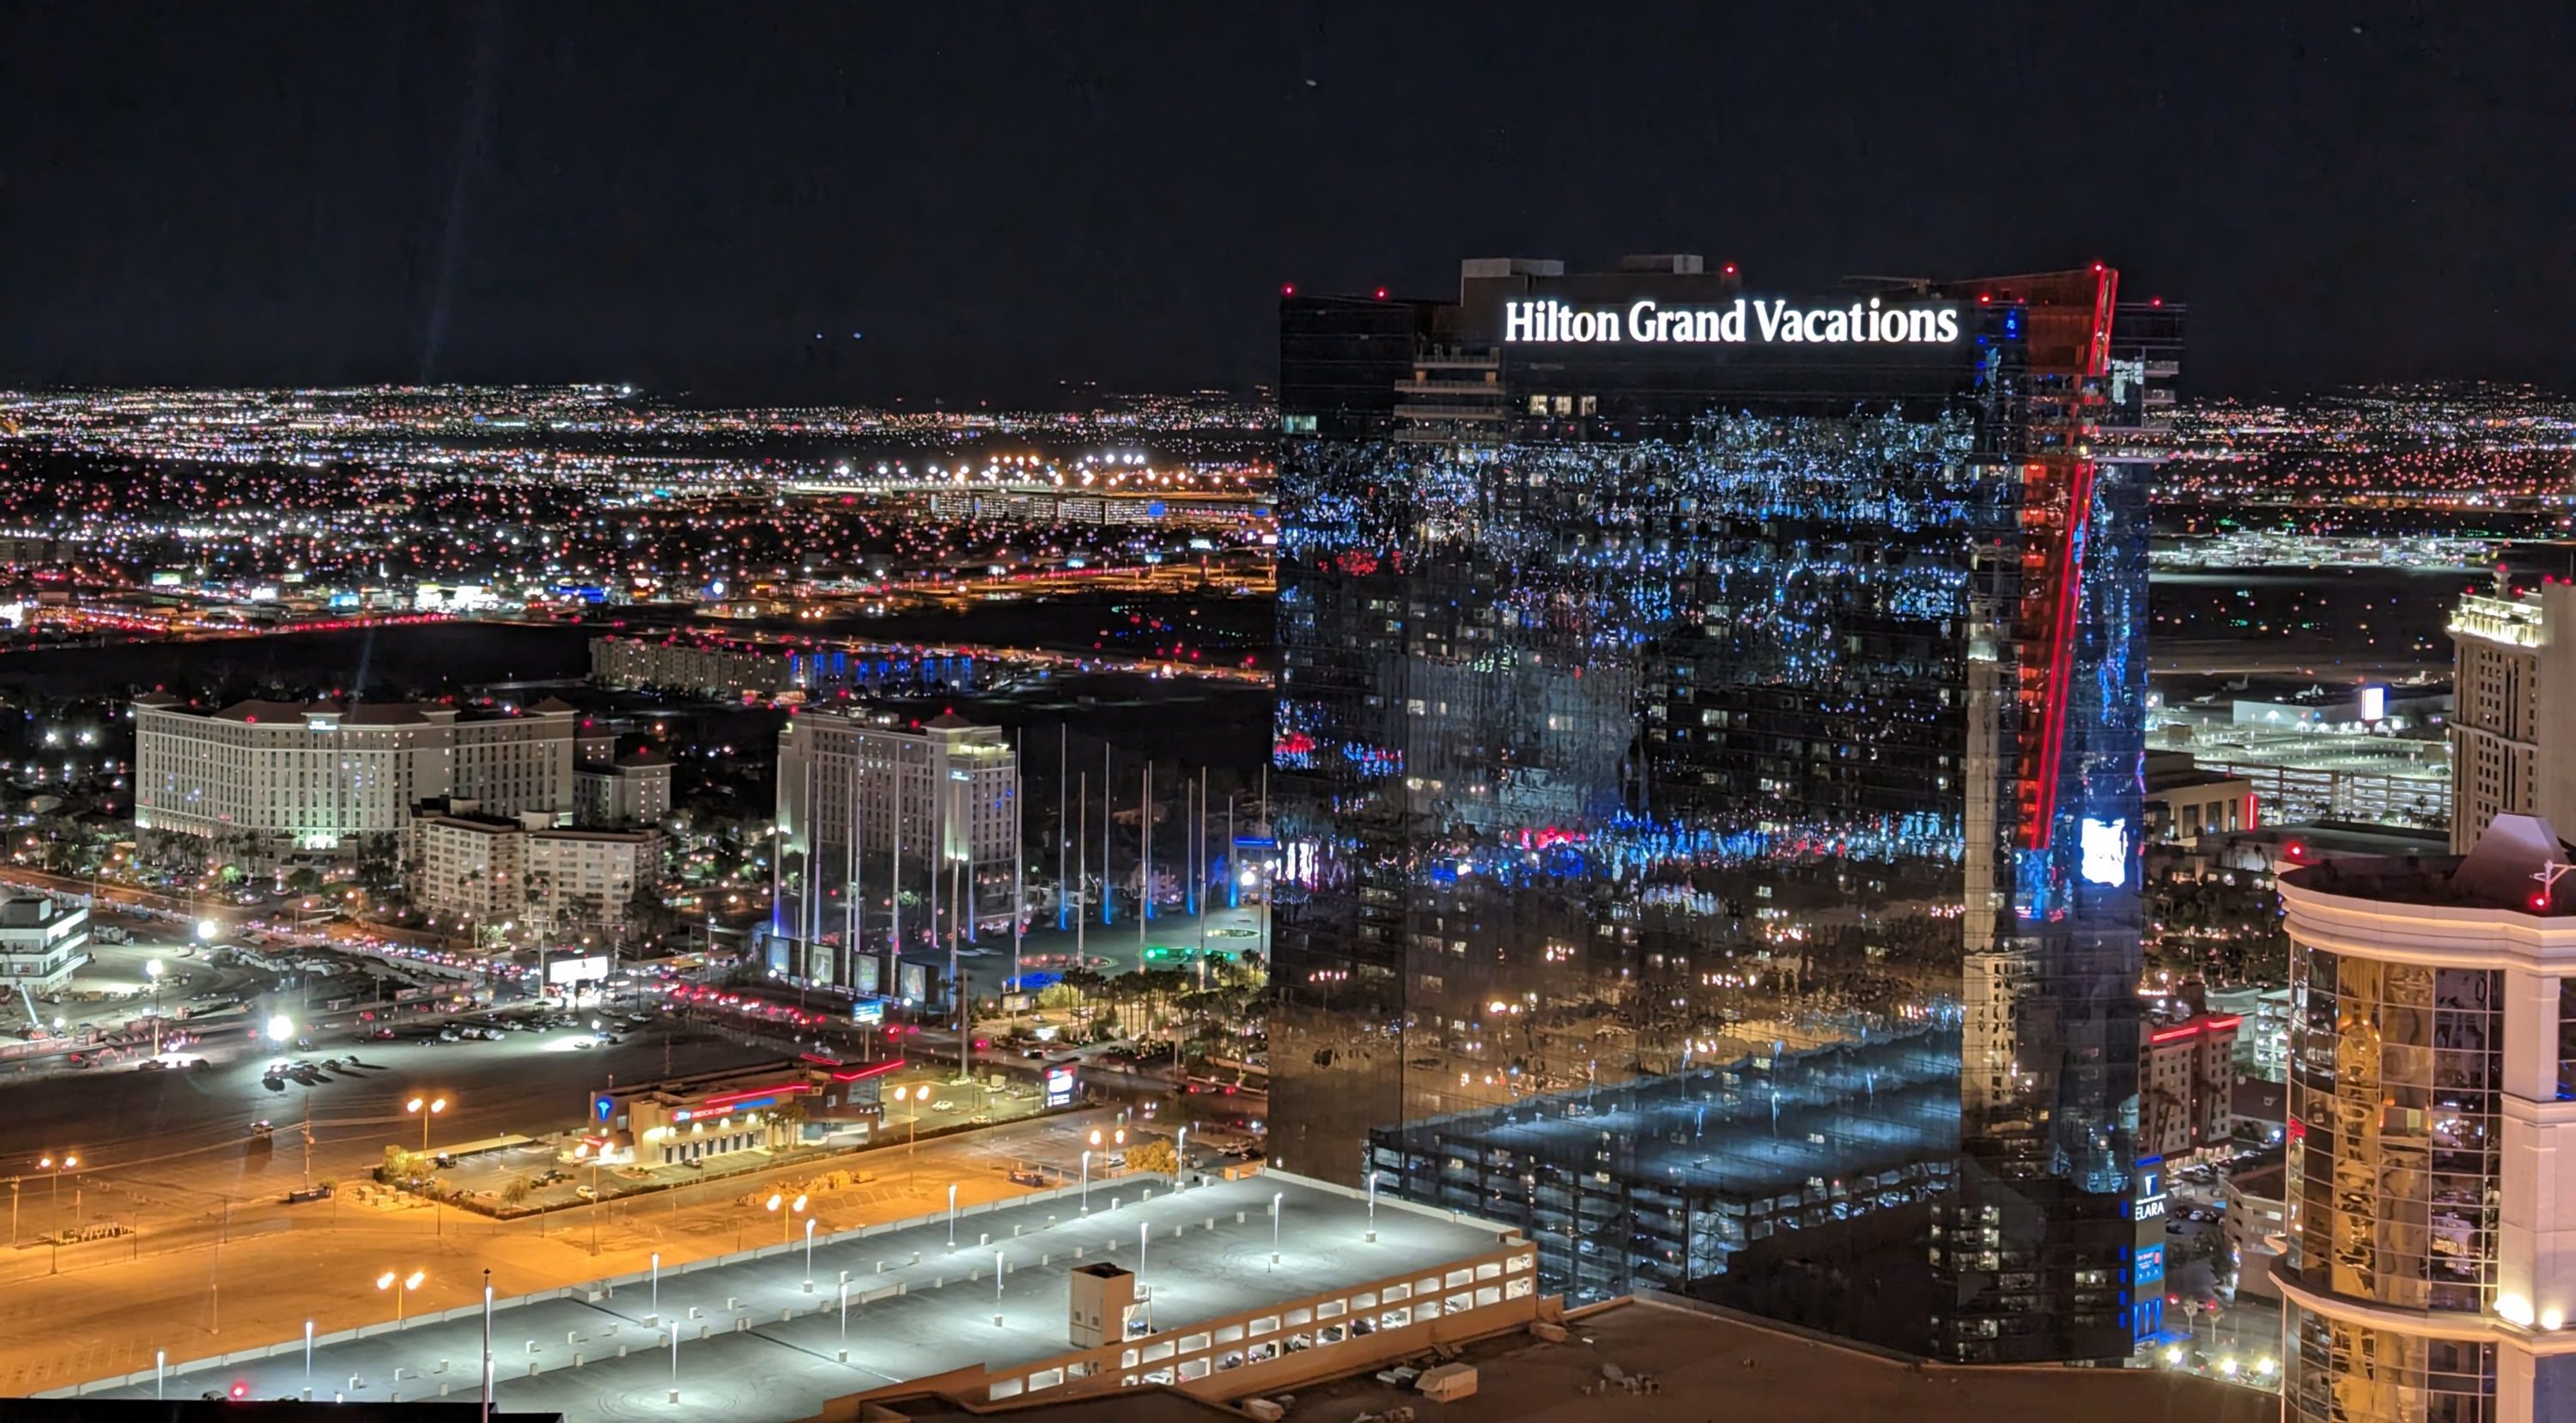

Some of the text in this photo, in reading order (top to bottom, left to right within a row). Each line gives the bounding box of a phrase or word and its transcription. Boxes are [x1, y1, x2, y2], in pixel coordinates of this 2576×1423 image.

[1504, 297, 1959, 342] Hilton Grand Vacations
[2135, 1201, 2165, 1221] ELARA
